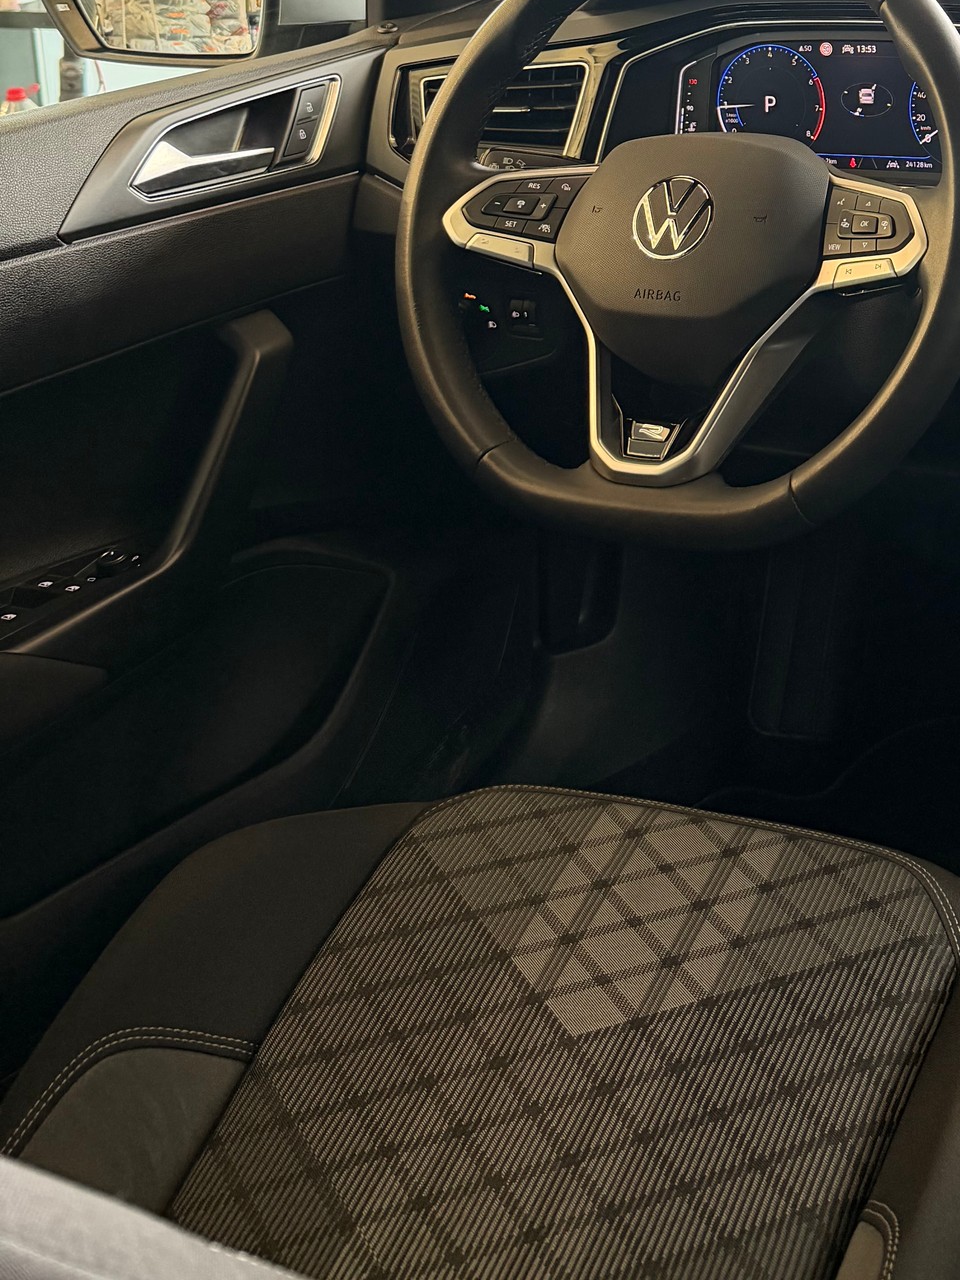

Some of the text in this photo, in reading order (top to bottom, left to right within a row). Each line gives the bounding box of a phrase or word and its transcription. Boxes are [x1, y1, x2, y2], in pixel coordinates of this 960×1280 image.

[856, 45, 877, 53] 13:53
[764, 95, 777, 113] P
[528, 182, 541, 190] RES
[505, 220, 517, 228] SET
[634, 288, 681, 302] AIRBAG
